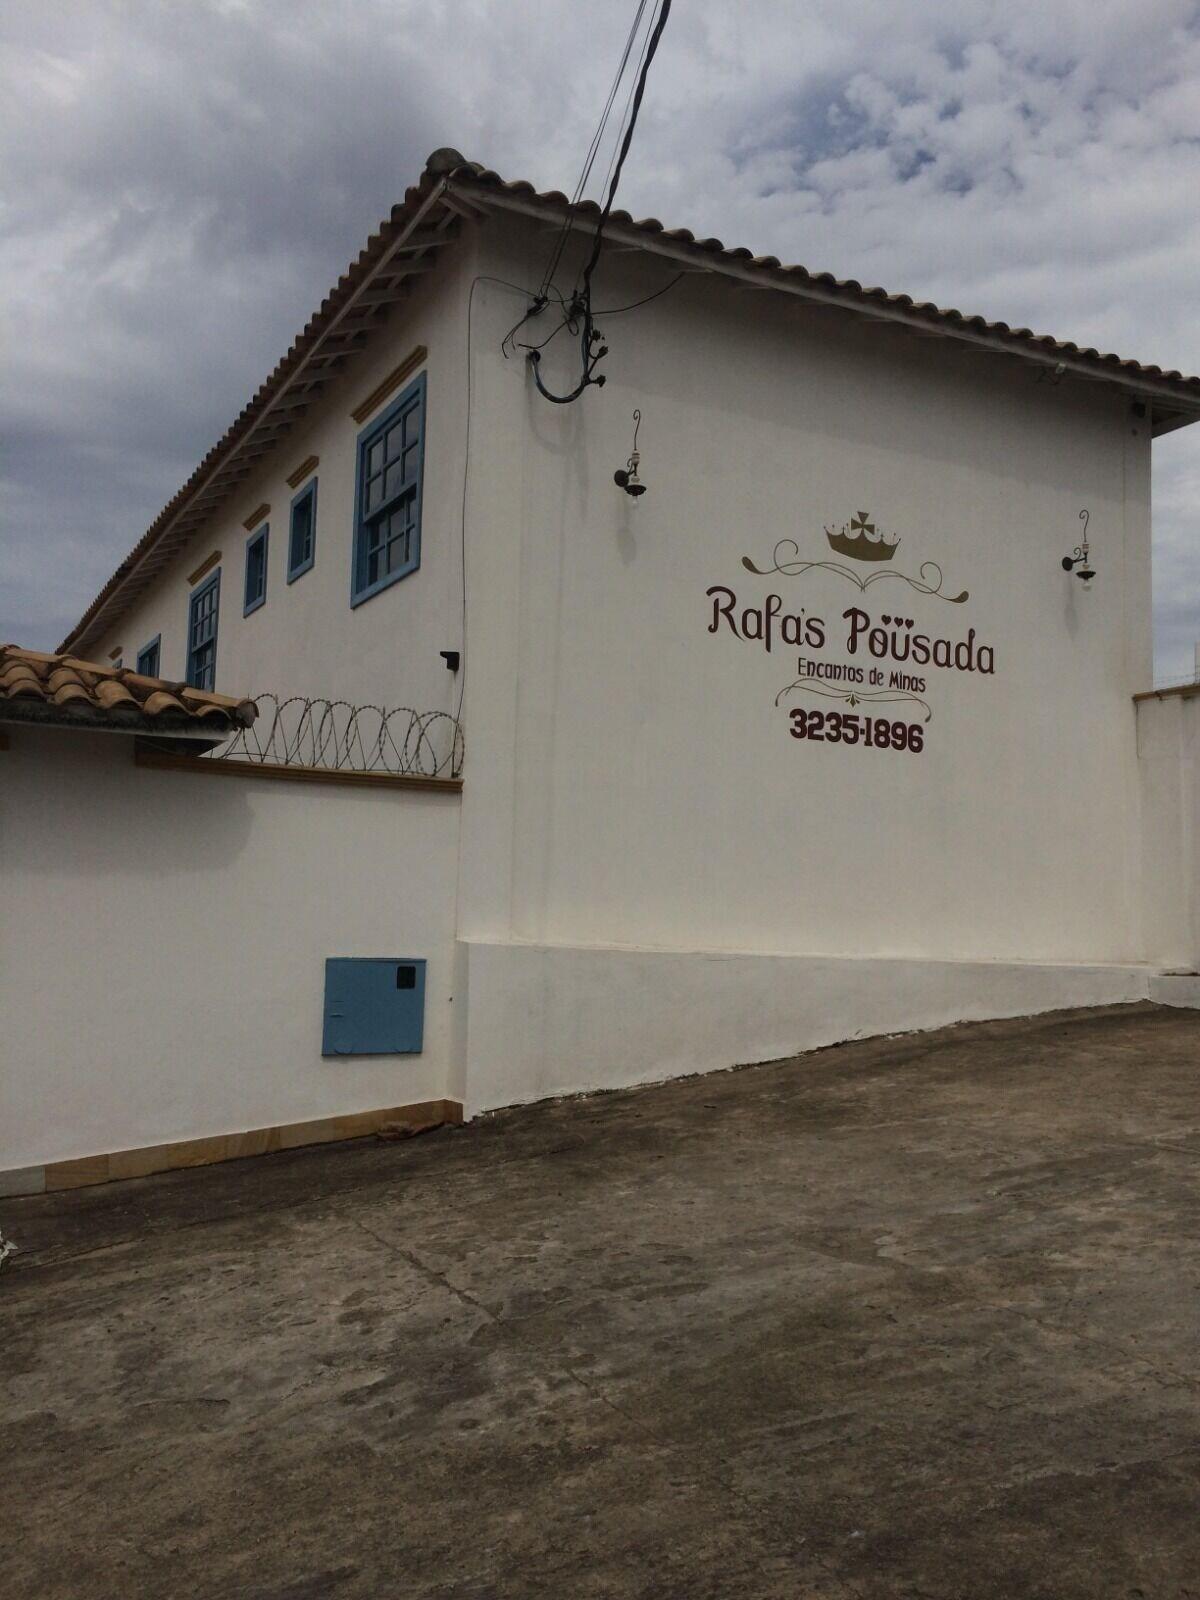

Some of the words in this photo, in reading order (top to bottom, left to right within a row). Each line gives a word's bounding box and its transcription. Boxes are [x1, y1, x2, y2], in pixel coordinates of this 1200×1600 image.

[706, 586, 826, 652] Rafa's
[798, 657, 864, 684] Encantos
[869, 667, 885, 686] de
[889, 670, 926, 693] Minas
[789, 709, 924, 753] 3235-1896
